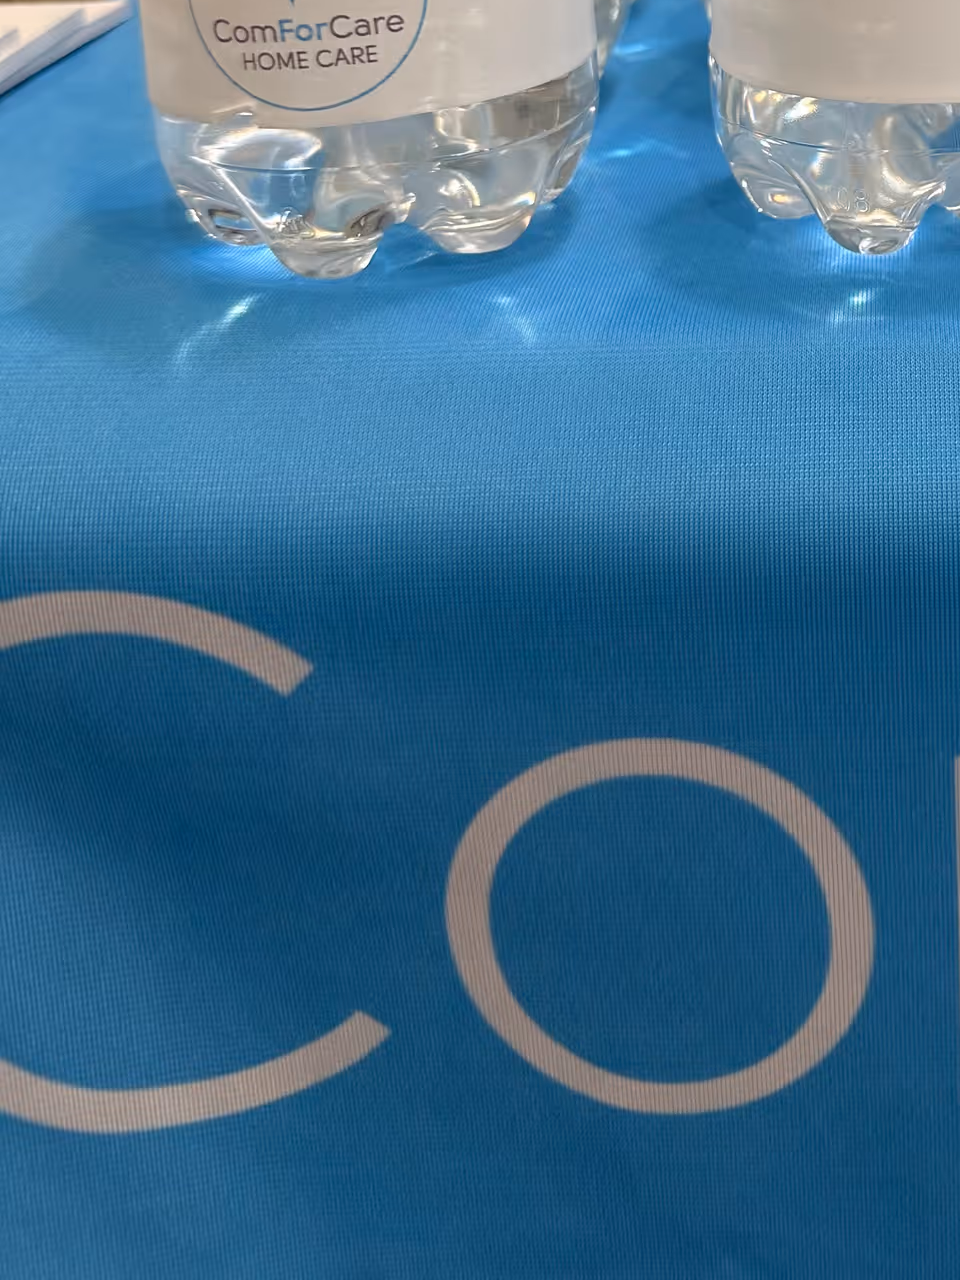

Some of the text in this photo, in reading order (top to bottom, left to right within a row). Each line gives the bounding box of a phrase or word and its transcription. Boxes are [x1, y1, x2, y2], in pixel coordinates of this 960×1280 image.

[213, 14, 405, 44] ComForCare
[242, 45, 379, 71] HOME CARE
